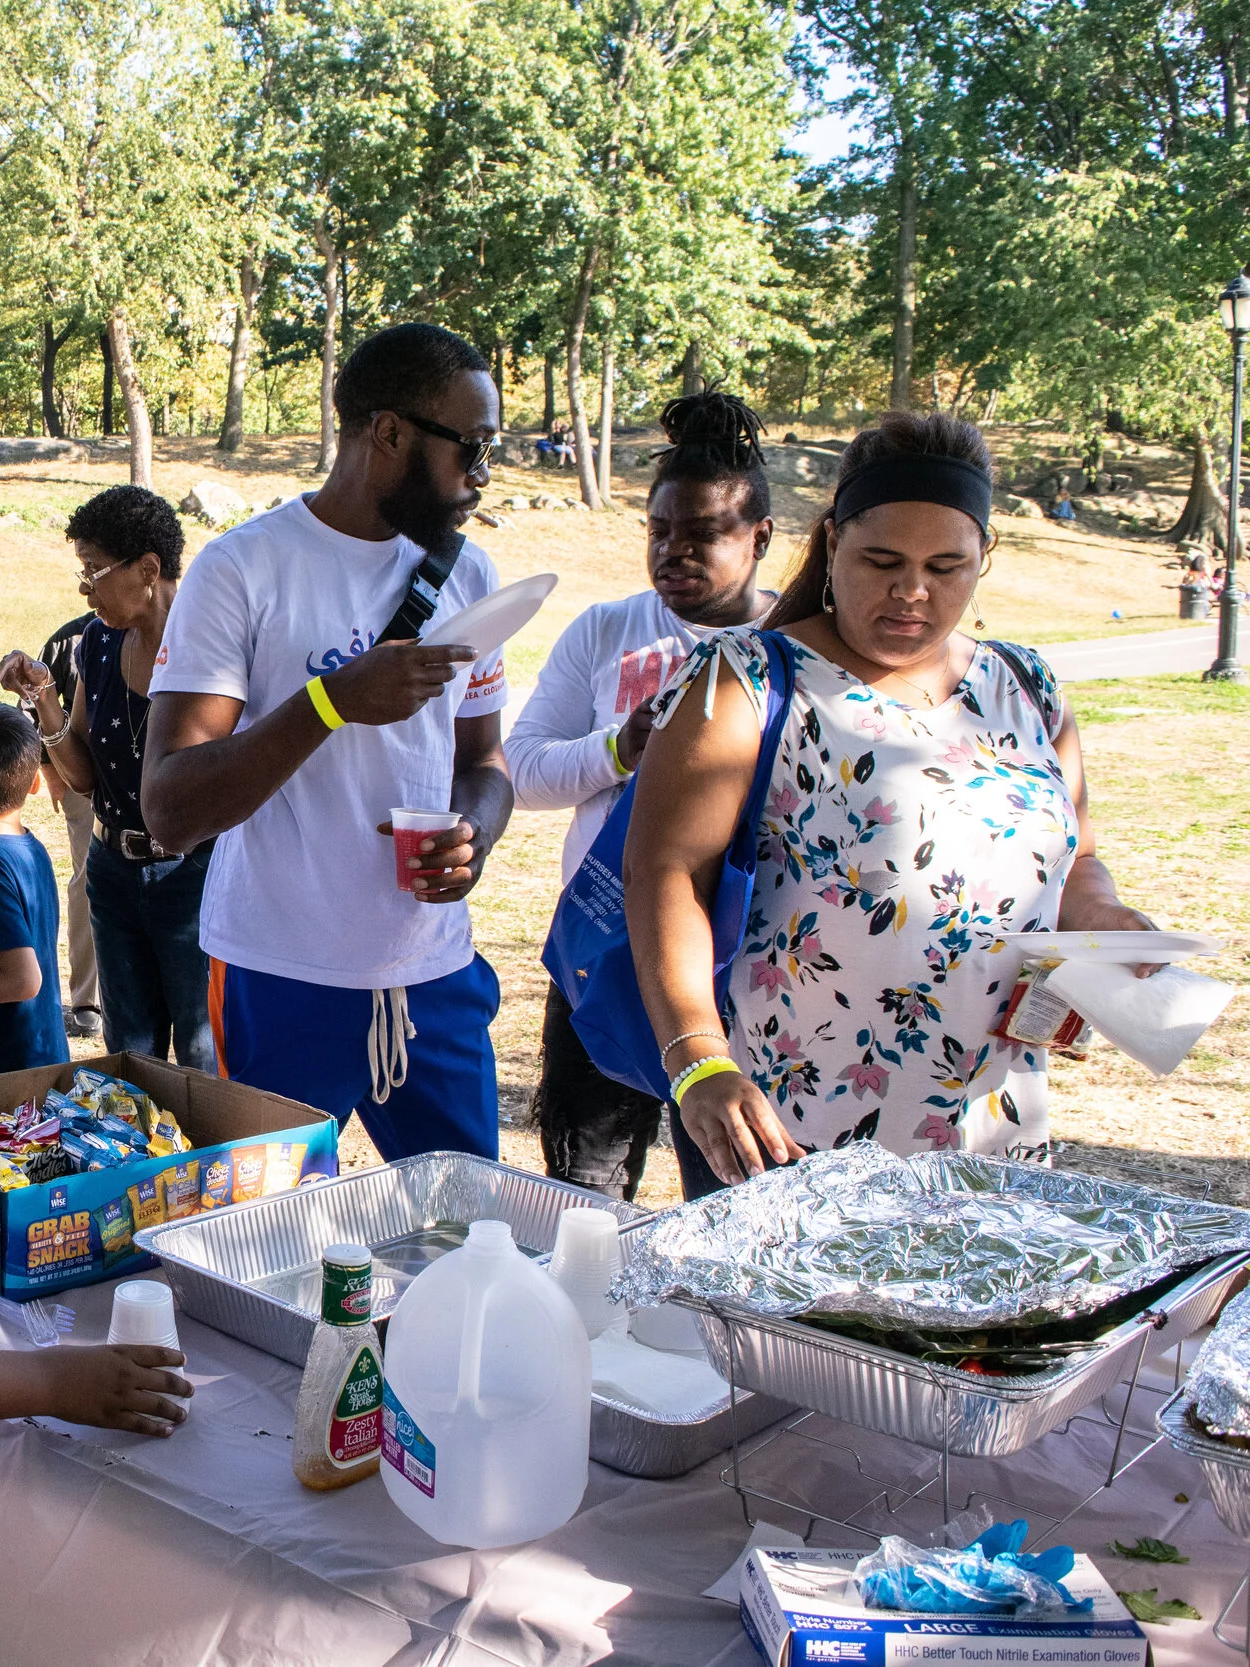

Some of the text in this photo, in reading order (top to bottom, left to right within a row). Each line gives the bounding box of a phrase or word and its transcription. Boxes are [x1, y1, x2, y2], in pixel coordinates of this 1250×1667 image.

[585, 853, 613, 879] NURSES
[587, 868, 611, 889] MOUNT
[175, 1171, 188, 1179] WISE
[206, 1164, 231, 1178] Cheez
[139, 1187, 155, 1199] WISE
[50, 1197, 67, 1208] WISE
[105, 1207, 121, 1219] WISE
[28, 1211, 91, 1243] GRAB
[28, 1238, 91, 1269] SNACK
[346, 1414, 377, 1434] Zesty
[343, 1427, 378, 1447] Italian
[765, 1550, 798, 1560] HHC
[828, 1552, 854, 1560] HHC
[792, 1614, 868, 1626] Style Number
[795, 1620, 830, 1630] HHC
[903, 1622, 1136, 1638] LARGE Examination Gloves
[806, 1639, 841, 1657] HHC
[894, 1645, 1141, 1663] HHC Better Touch Nitrile Examination Gloves
